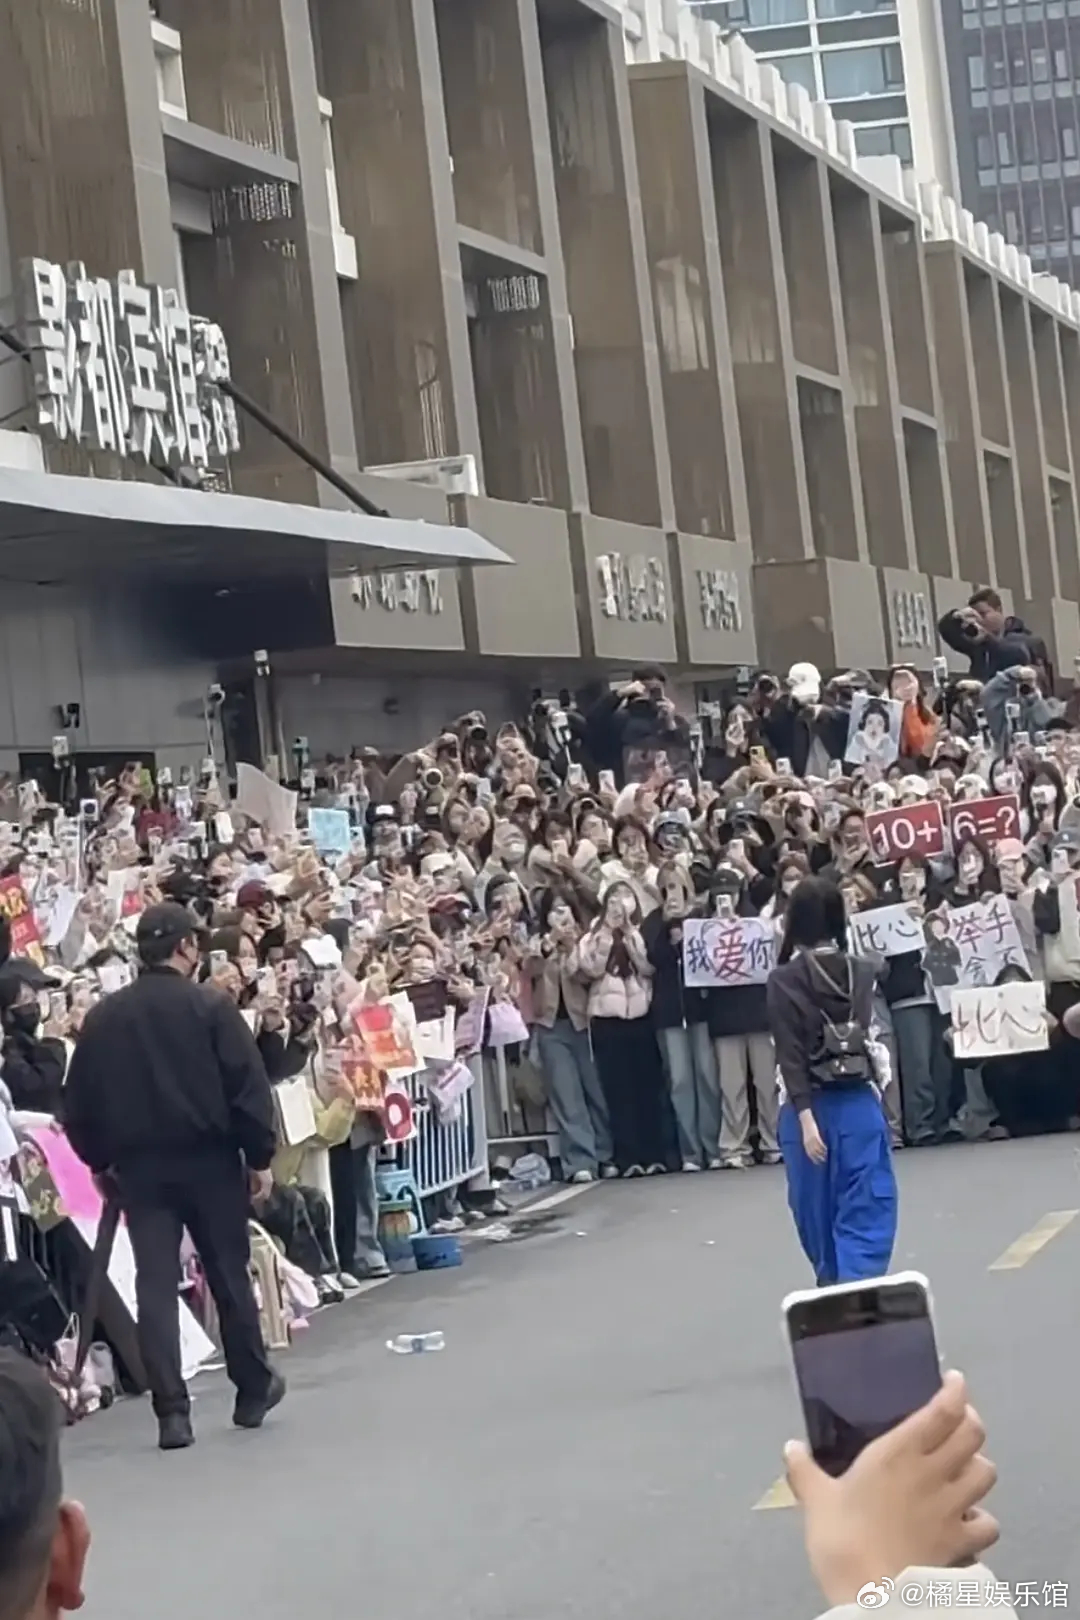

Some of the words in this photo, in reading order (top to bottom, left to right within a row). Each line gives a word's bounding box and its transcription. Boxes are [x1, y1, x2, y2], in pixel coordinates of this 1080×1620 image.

[872, 817, 939, 855] 10+
[857, 919, 920, 951] 比心
[953, 903, 1013, 953] 举手
[686, 926, 774, 979] 我爱你
